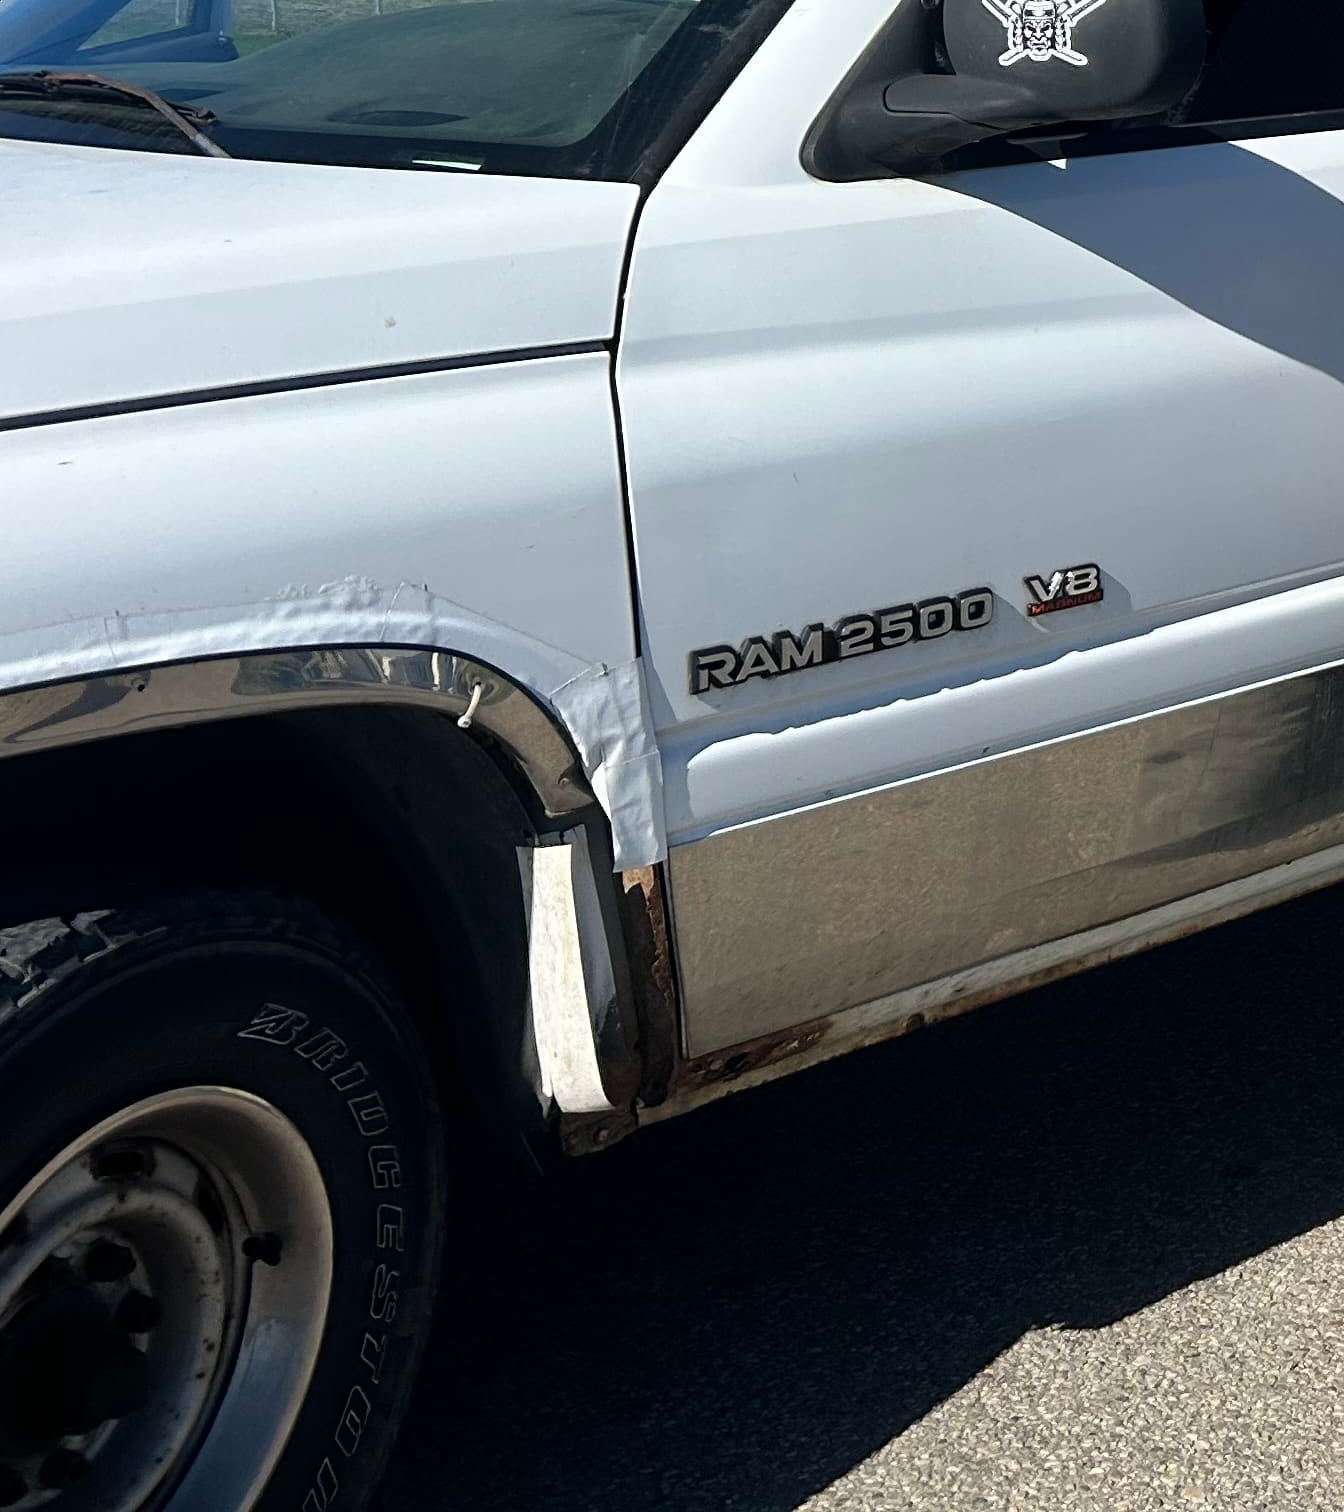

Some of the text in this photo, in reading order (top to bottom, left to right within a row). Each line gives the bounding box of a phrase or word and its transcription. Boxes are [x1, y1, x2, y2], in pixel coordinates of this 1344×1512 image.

[1027, 565, 1100, 602] V8
[692, 588, 994, 694] RAM 2500
